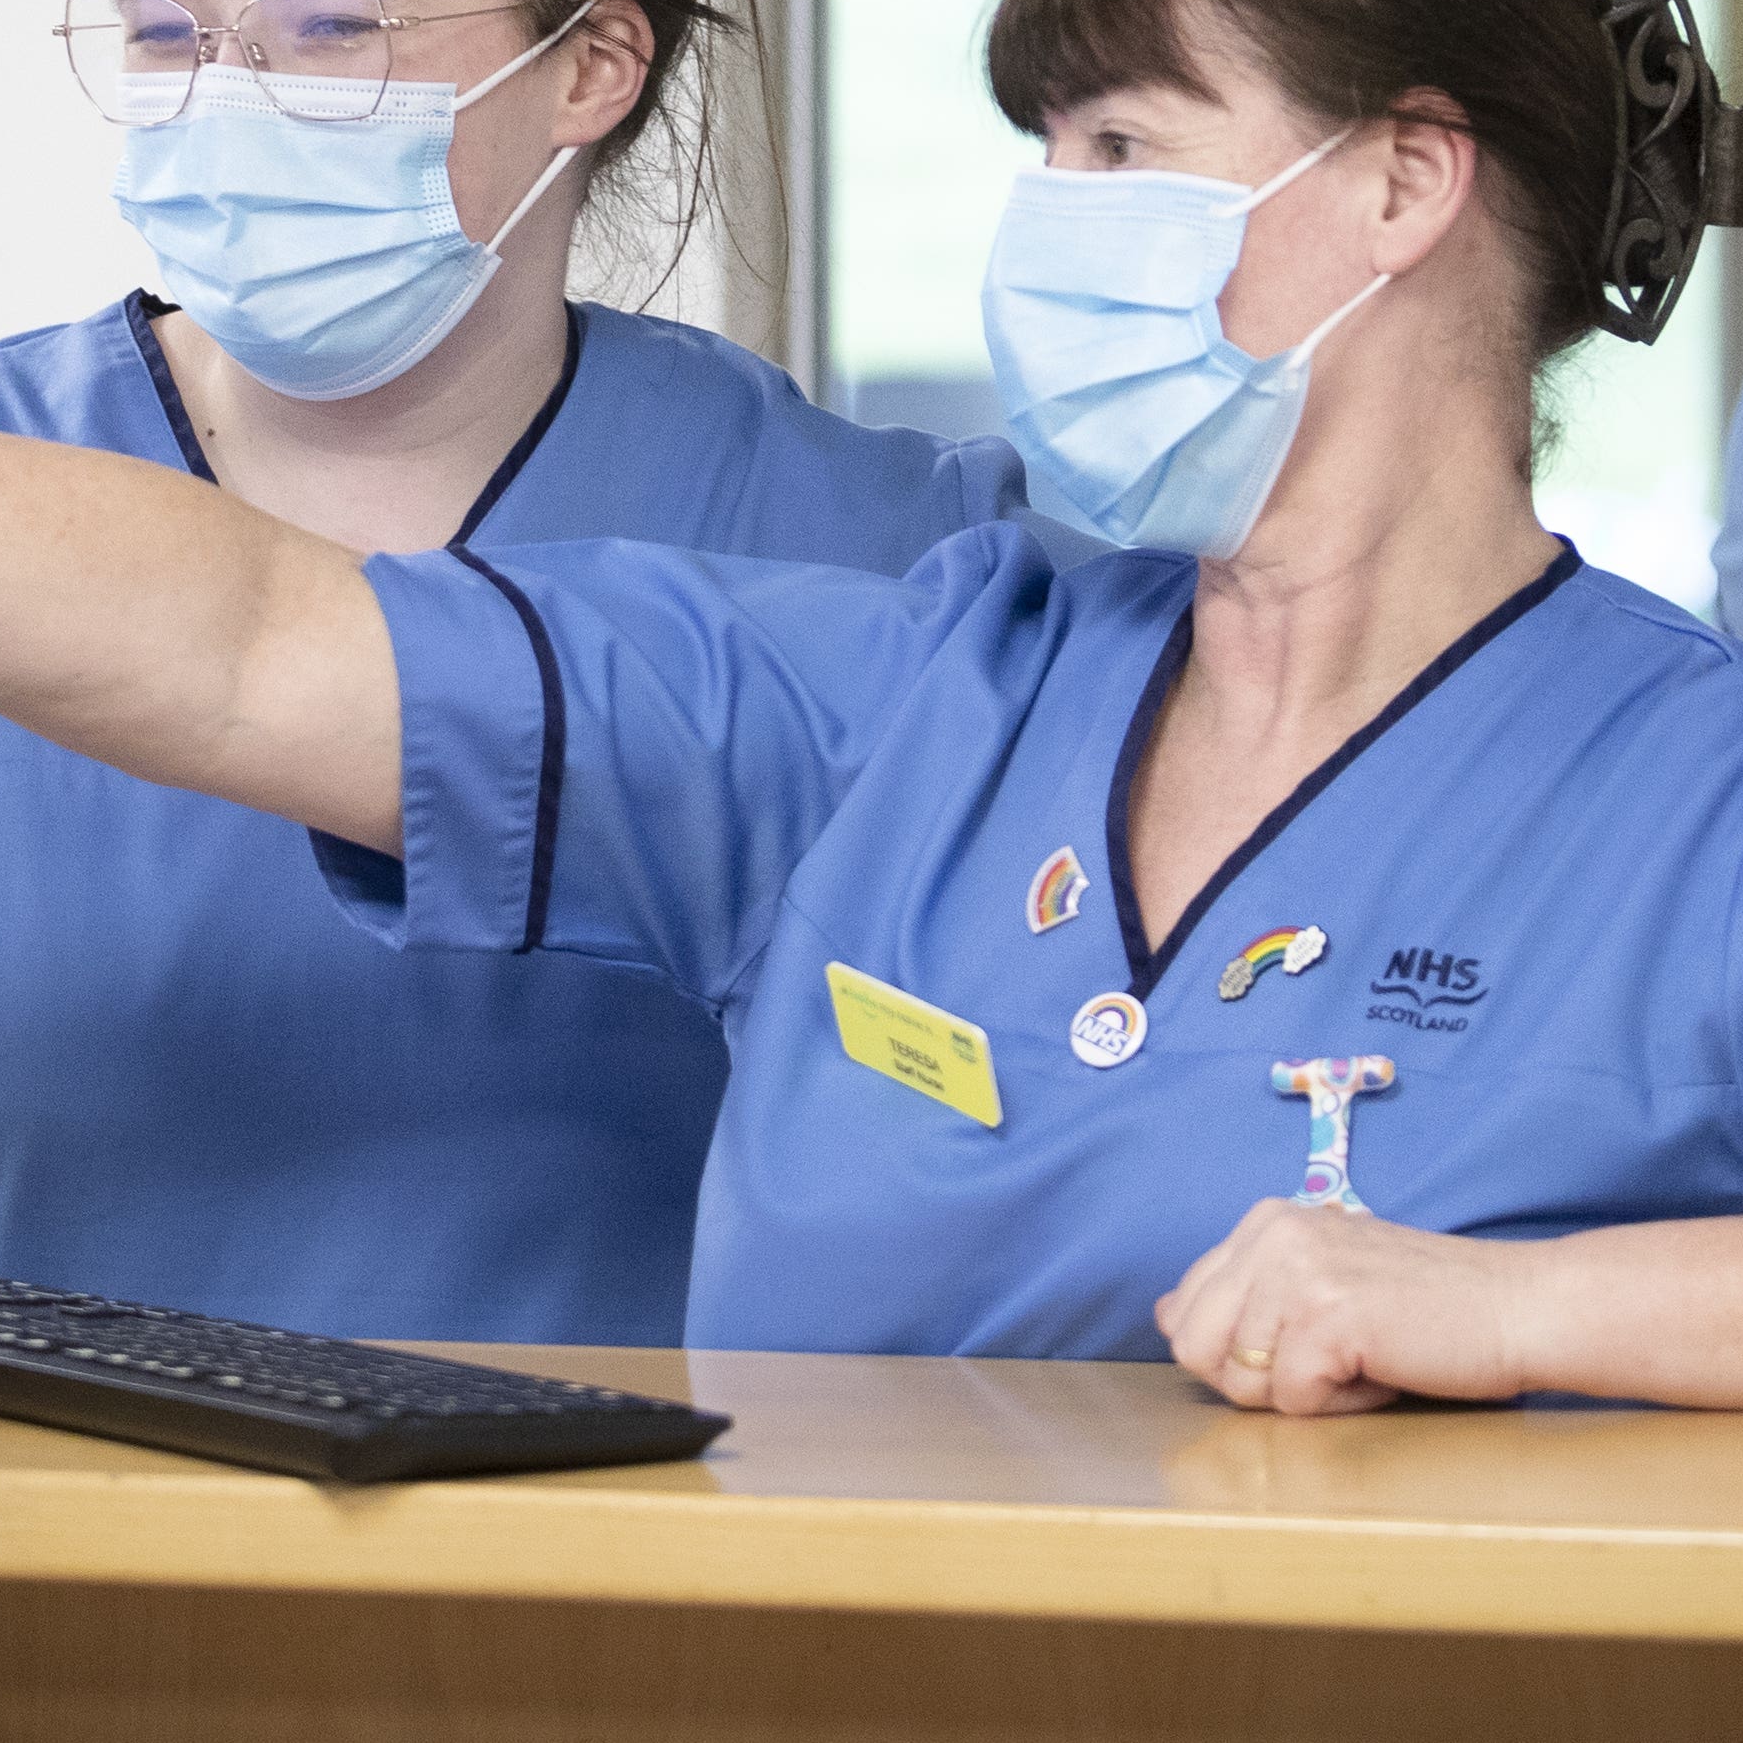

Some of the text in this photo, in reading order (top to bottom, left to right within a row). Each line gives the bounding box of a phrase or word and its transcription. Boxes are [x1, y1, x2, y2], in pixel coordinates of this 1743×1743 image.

[1383, 946, 1481, 991] NHS
[1075, 1016, 1130, 1055] NHS
[1365, 1004, 1469, 1032] SCOTLAND
[889, 1036, 942, 1073] TERESA
